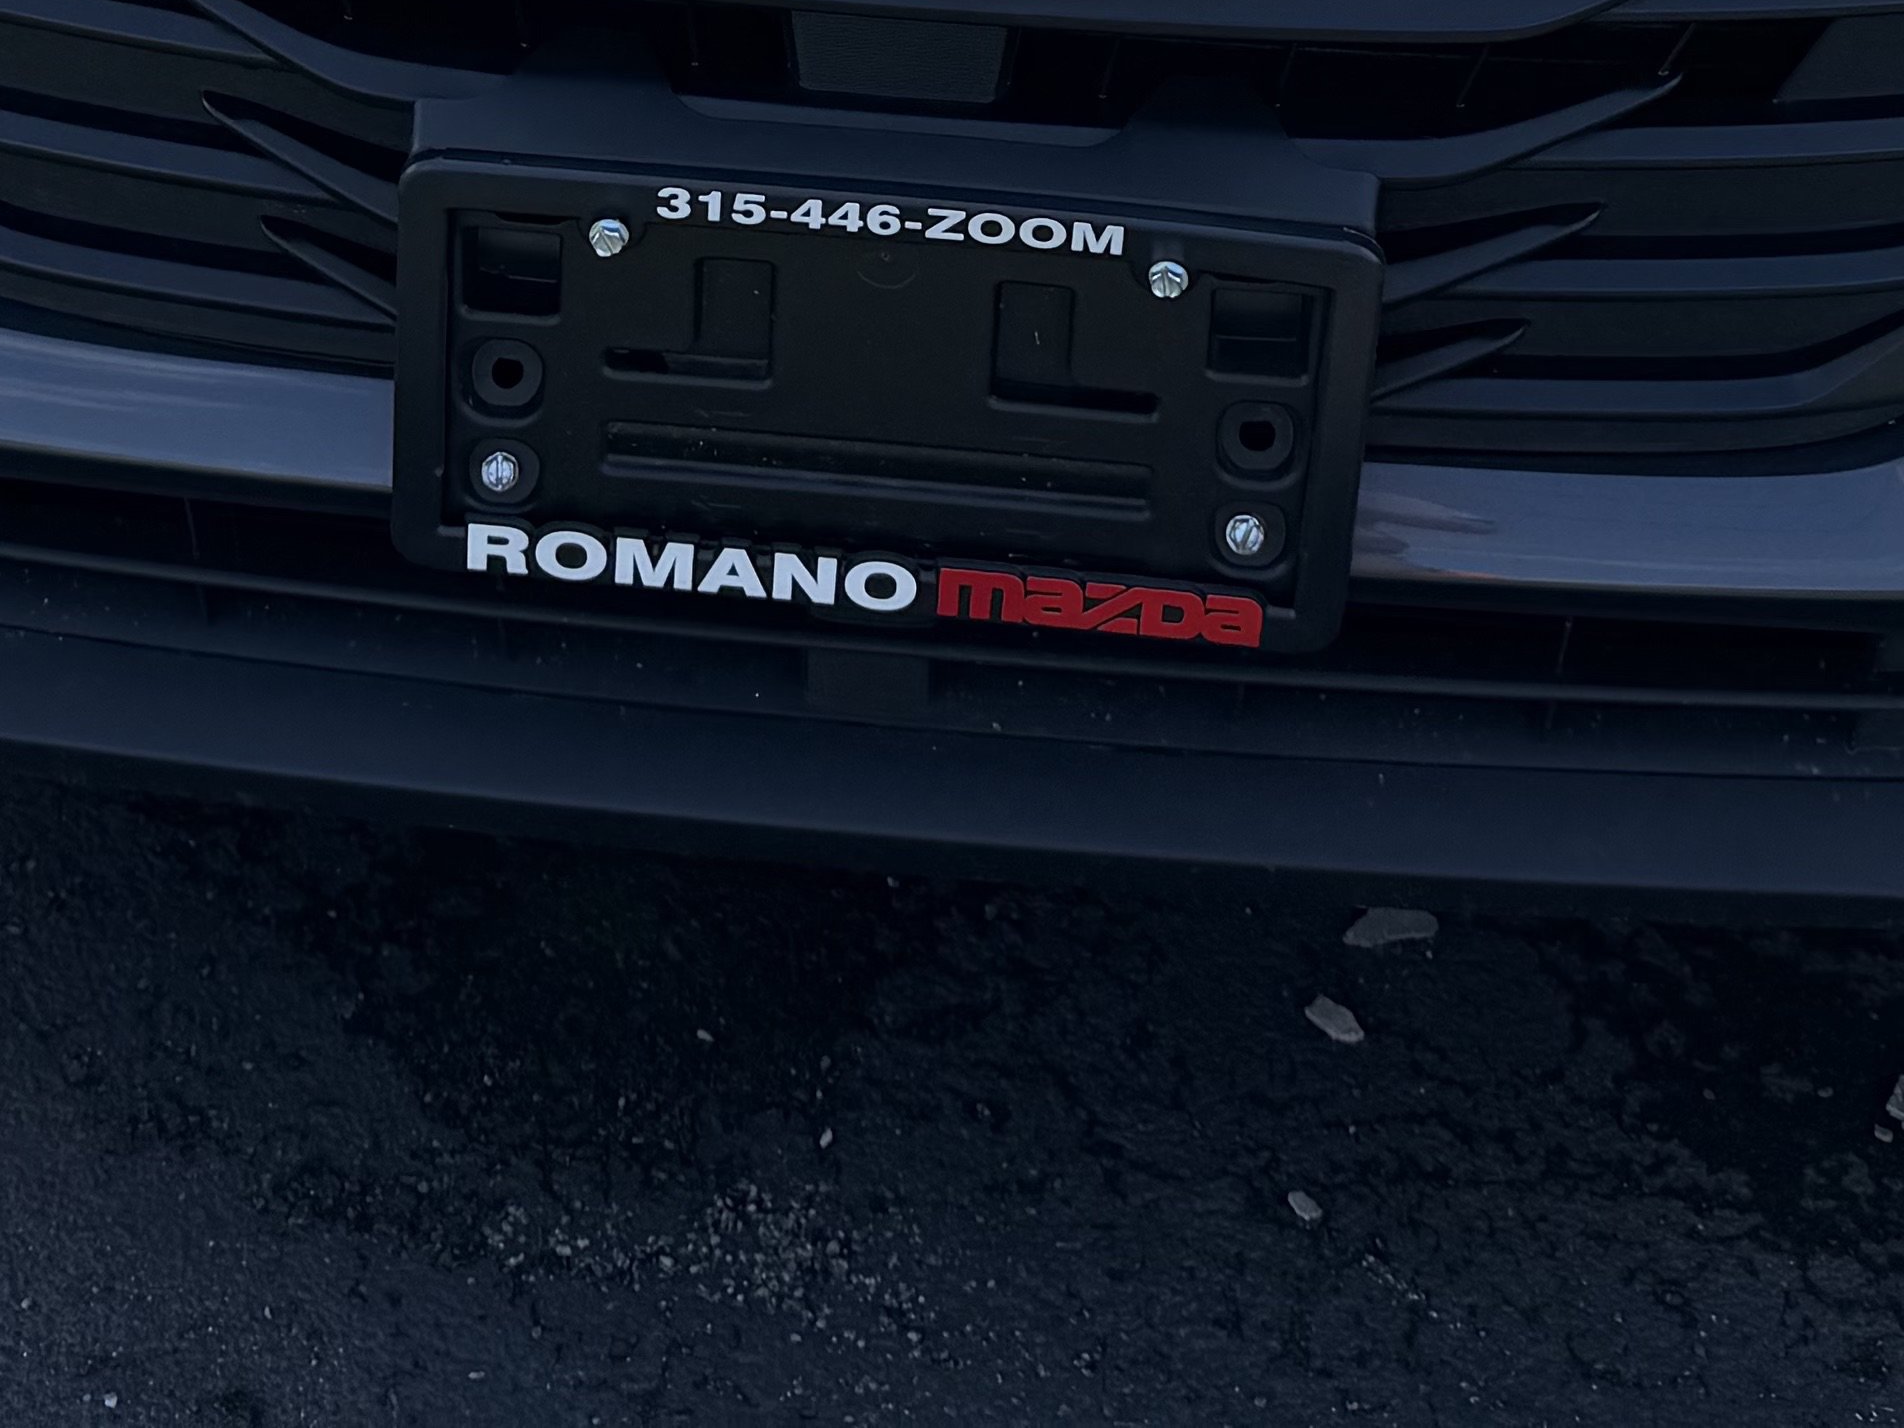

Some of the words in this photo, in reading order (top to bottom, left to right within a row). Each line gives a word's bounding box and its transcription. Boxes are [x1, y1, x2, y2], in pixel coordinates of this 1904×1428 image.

[655, 185, 1126, 257] 315-446-ZOOM
[465, 522, 918, 612] ROMANO
[935, 567, 1264, 649] mazda
